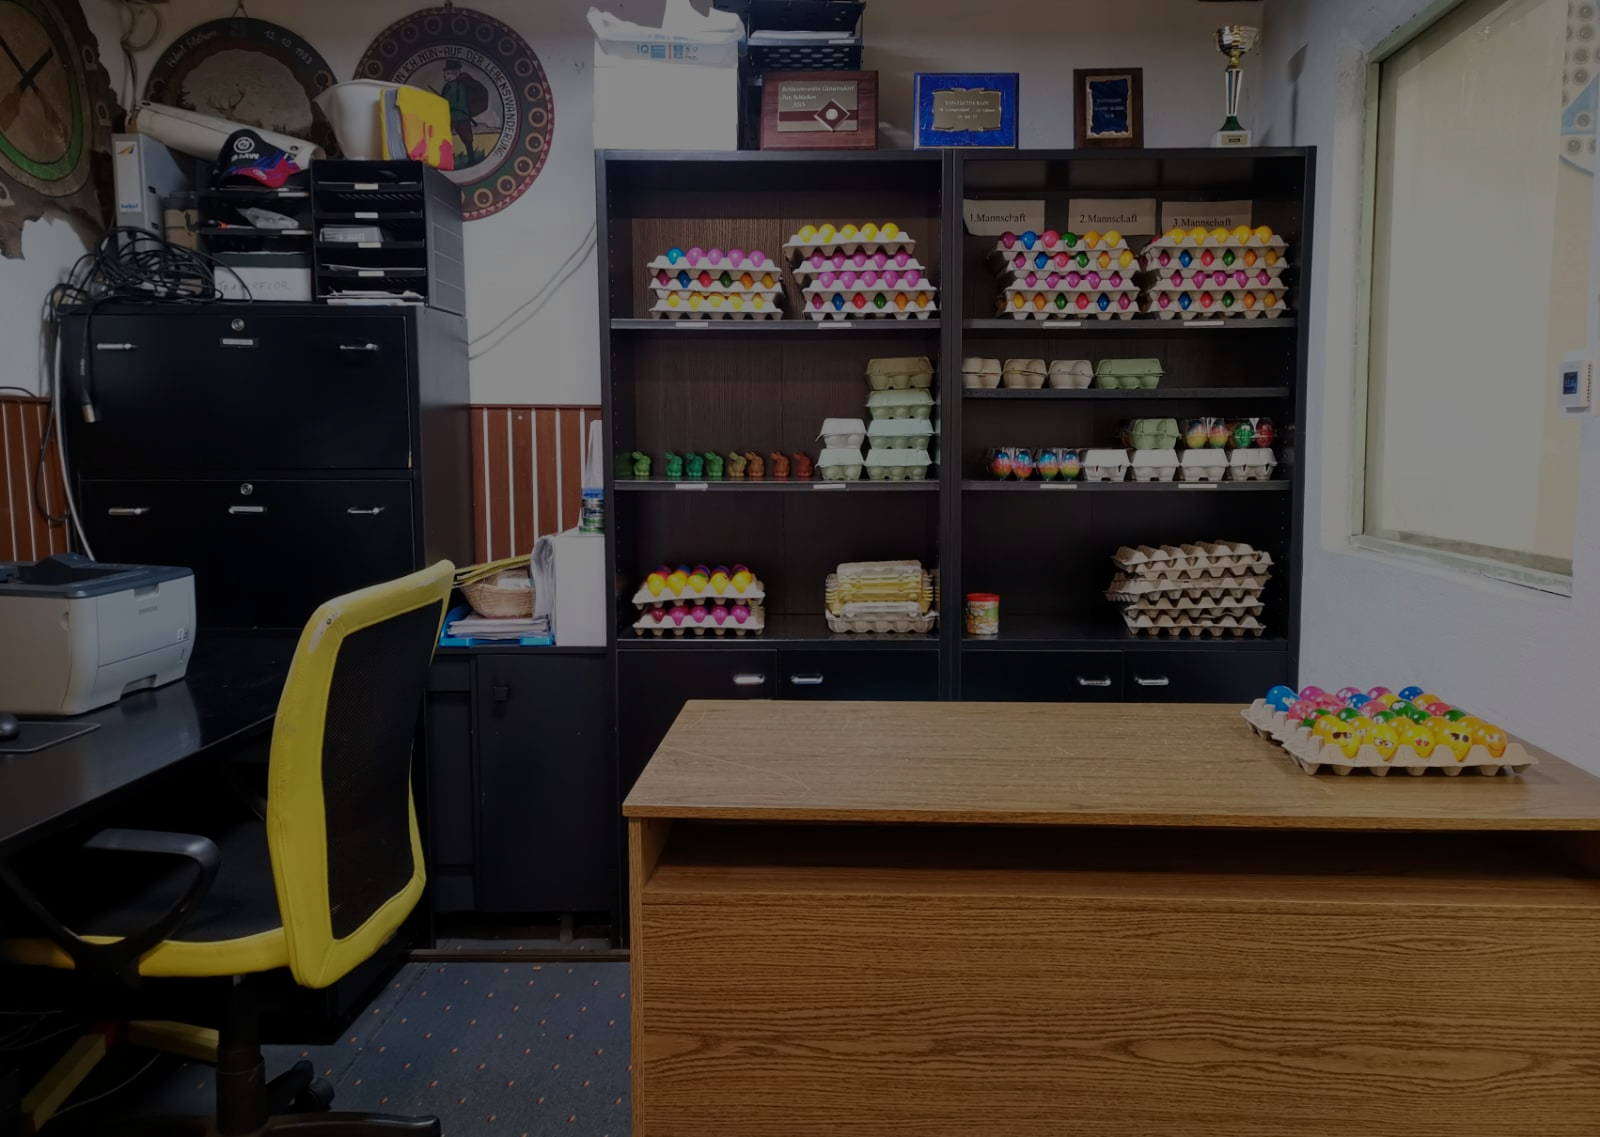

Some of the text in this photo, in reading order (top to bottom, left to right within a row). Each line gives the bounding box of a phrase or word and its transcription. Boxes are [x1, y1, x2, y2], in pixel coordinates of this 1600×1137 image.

[466, 50, 485, 66] DER
[970, 213, 1026, 223] 1.Mannschaft
[1079, 213, 1138, 224] 2.Mannschaft
[1172, 217, 1232, 228] 3.Mannschaft
